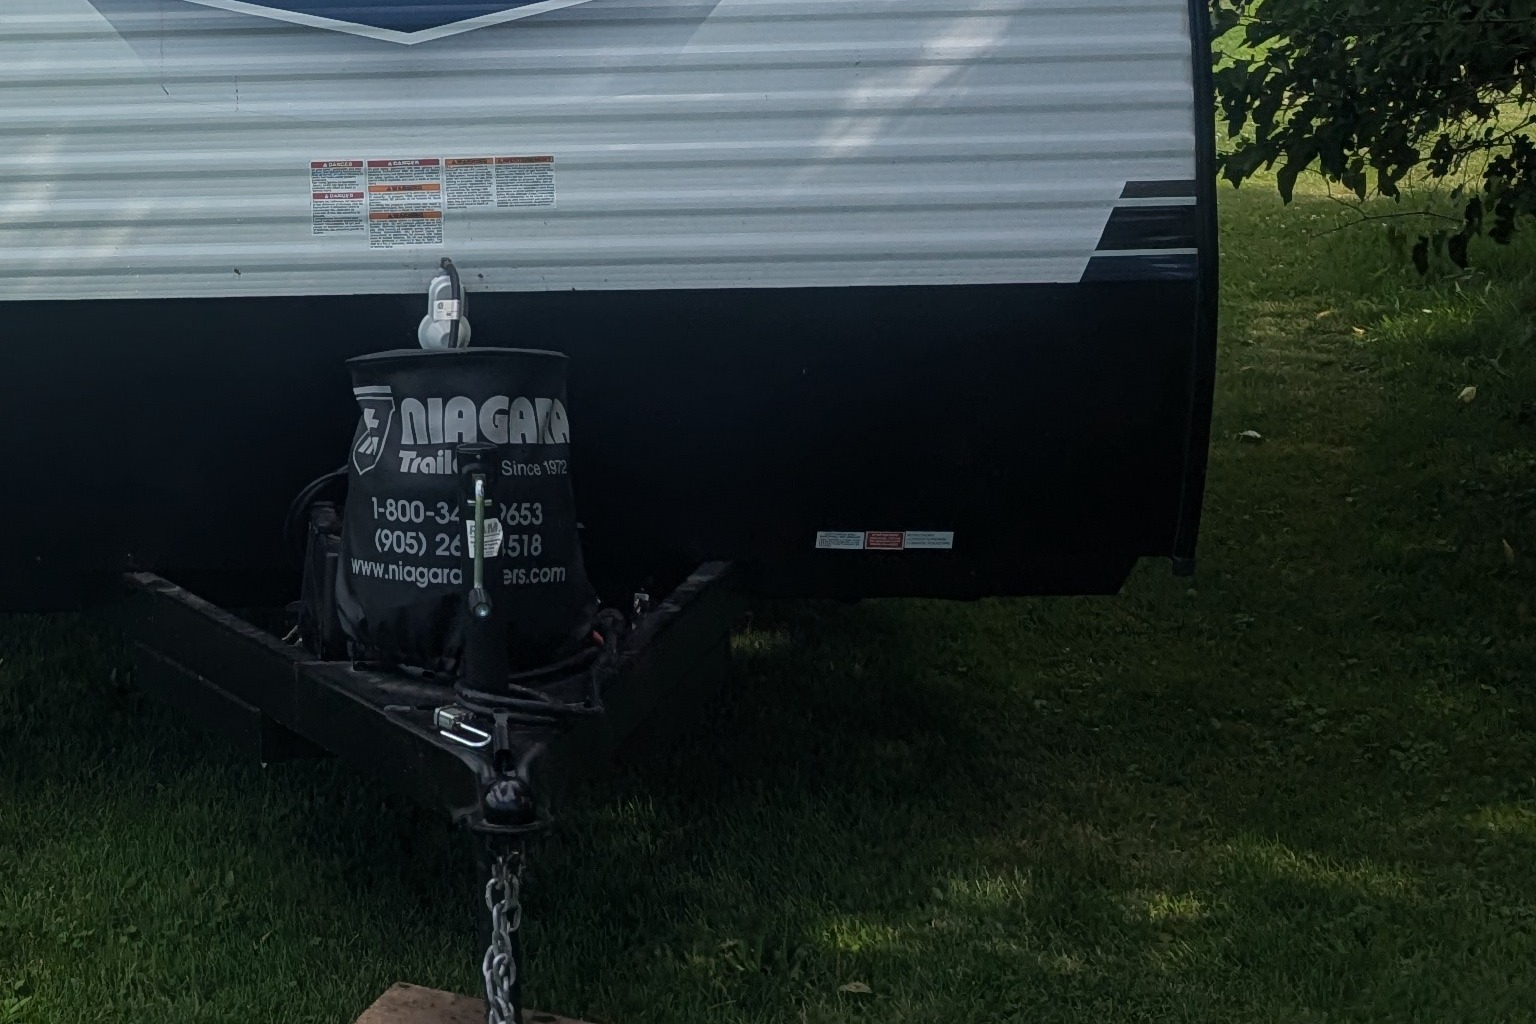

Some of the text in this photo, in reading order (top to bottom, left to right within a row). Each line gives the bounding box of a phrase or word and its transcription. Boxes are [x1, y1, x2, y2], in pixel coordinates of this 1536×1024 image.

[400, 395, 571, 445] NIAGARA
[501, 459, 568, 476] Since 1972
[375, 528, 427, 557] (905)
